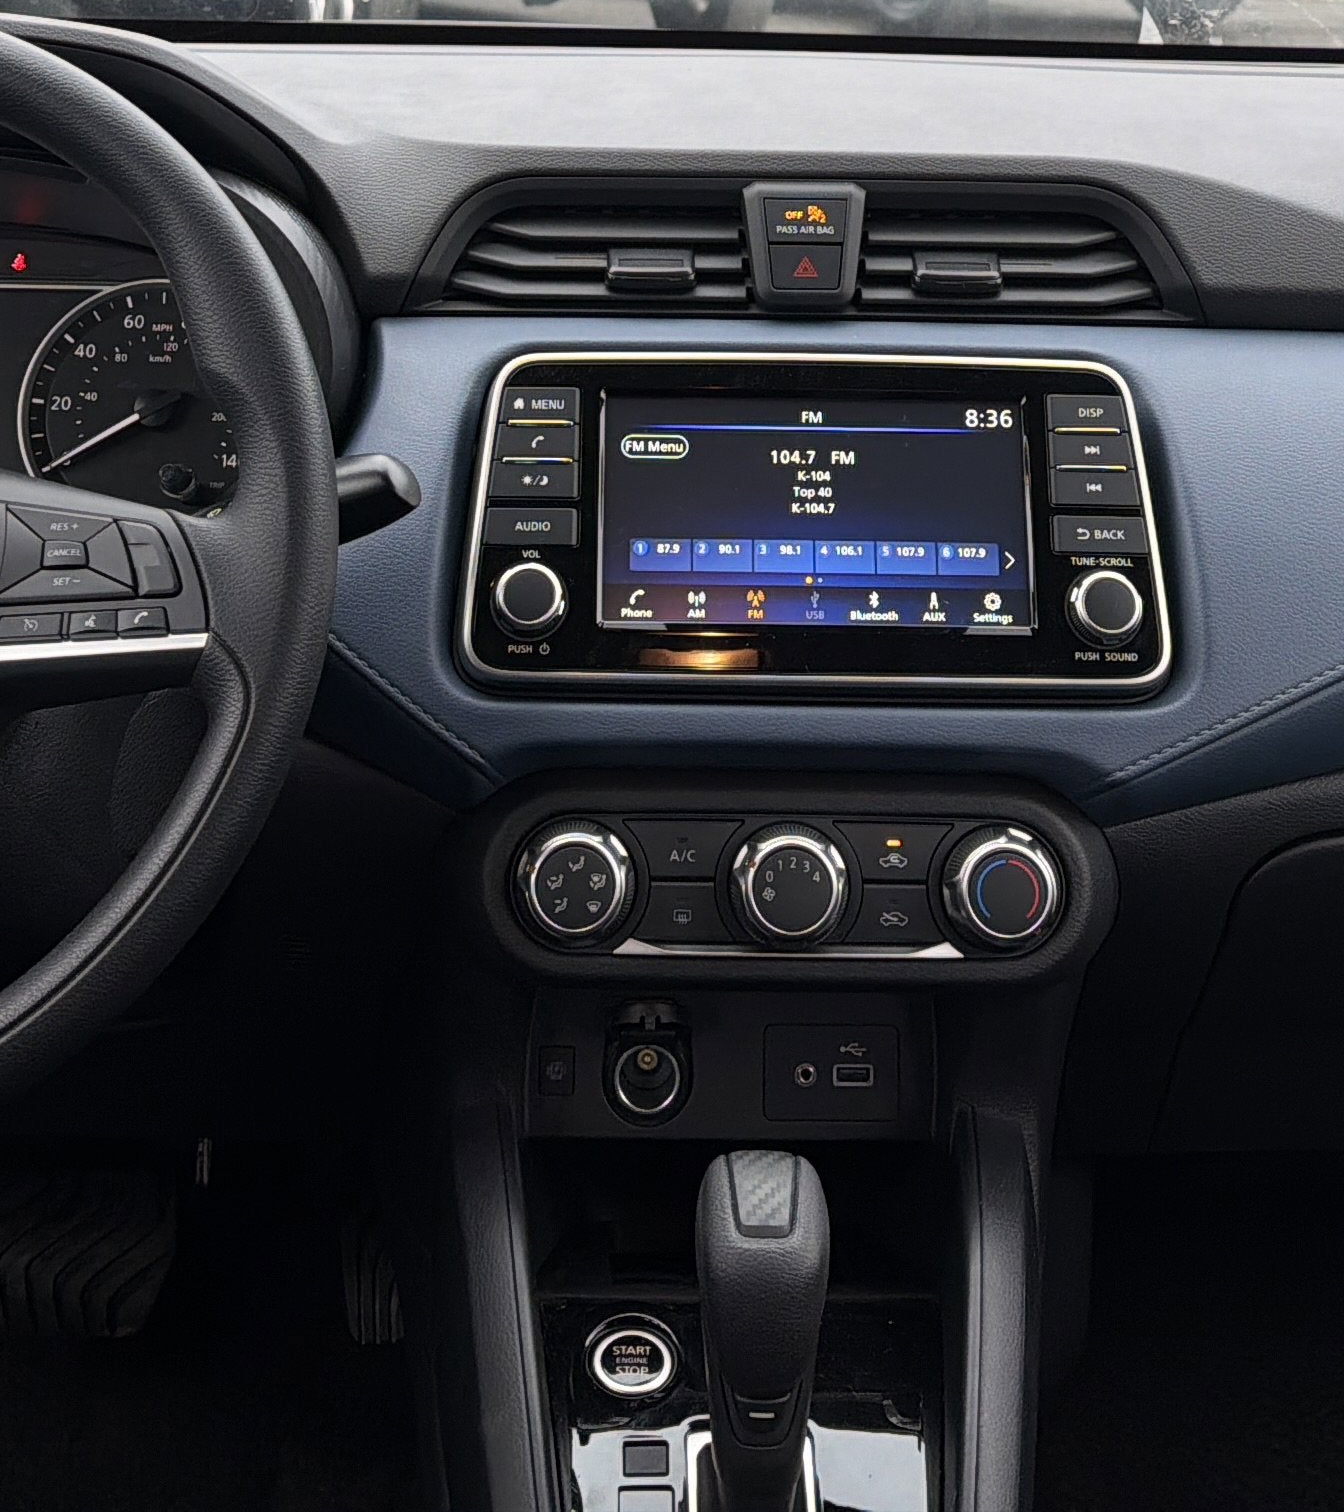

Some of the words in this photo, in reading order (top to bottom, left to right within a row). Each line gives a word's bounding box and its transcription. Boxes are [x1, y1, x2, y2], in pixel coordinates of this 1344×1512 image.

[784, 210, 804, 221] OFF
[776, 225, 798, 234] PASS
[800, 225, 815, 234] AIR
[816, 225, 835, 235] BAG
[123, 315, 144, 329] 60
[152, 324, 173, 332] MPH
[74, 343, 96, 358] 40
[163, 342, 178, 352] 120
[114, 353, 128, 362] 80
[148, 354, 172, 363] km/h
[84, 392, 98, 401] 40
[50, 396, 72, 410] 20
[531, 398, 565, 411] MENU
[801, 410, 823, 424] FM
[1077, 406, 1104, 418] DISP
[964, 408, 1013, 429] 8:36
[625, 441, 645, 453] FM
[649, 441, 684, 453] Menu
[770, 450, 816, 465] 104.7
[831, 451, 855, 465] FM
[797, 471, 831, 482] K-104
[793, 487, 815, 500] Top
[817, 487, 832, 498] 40
[791, 503, 835, 514] K-104.7
[514, 520, 551, 533] AUDIO
[1094, 529, 1125, 540] BACK
[46, 547, 82, 558] CANCEL
[522, 550, 542, 559] VOL
[656, 543, 680, 555] 87.9
[718, 544, 741, 555] 90.1
[759, 544, 767, 555] 3
[779, 544, 802, 556] 98.1
[820, 546, 828, 556] 4
[835, 545, 863, 557] 106.1
[882, 546, 890, 557] 5
[896, 546, 925, 558] 107.9
[957, 547, 986, 559] 107.9
[620, 607, 653, 619] Phone
[687, 608, 706, 619] AM
[747, 609, 763, 620] FM
[806, 609, 825, 621] USB
[850, 610, 899, 622] Bluetooth
[922, 612, 946, 622] AUX
[973, 612, 1013, 626] Settings
[507, 644, 533, 654] PUSH
[1074, 651, 1100, 661] PUSH
[1105, 652, 1138, 662] SOUND
[669, 849, 696, 863] A/C
[765, 870, 774, 883] 0
[778, 860, 784, 872] 1
[790, 857, 797, 869] 2
[803, 860, 811, 872] 3
[812, 870, 821, 883] 4
[612, 1345, 651, 1355] START
[615, 1365, 649, 1376] STOP
